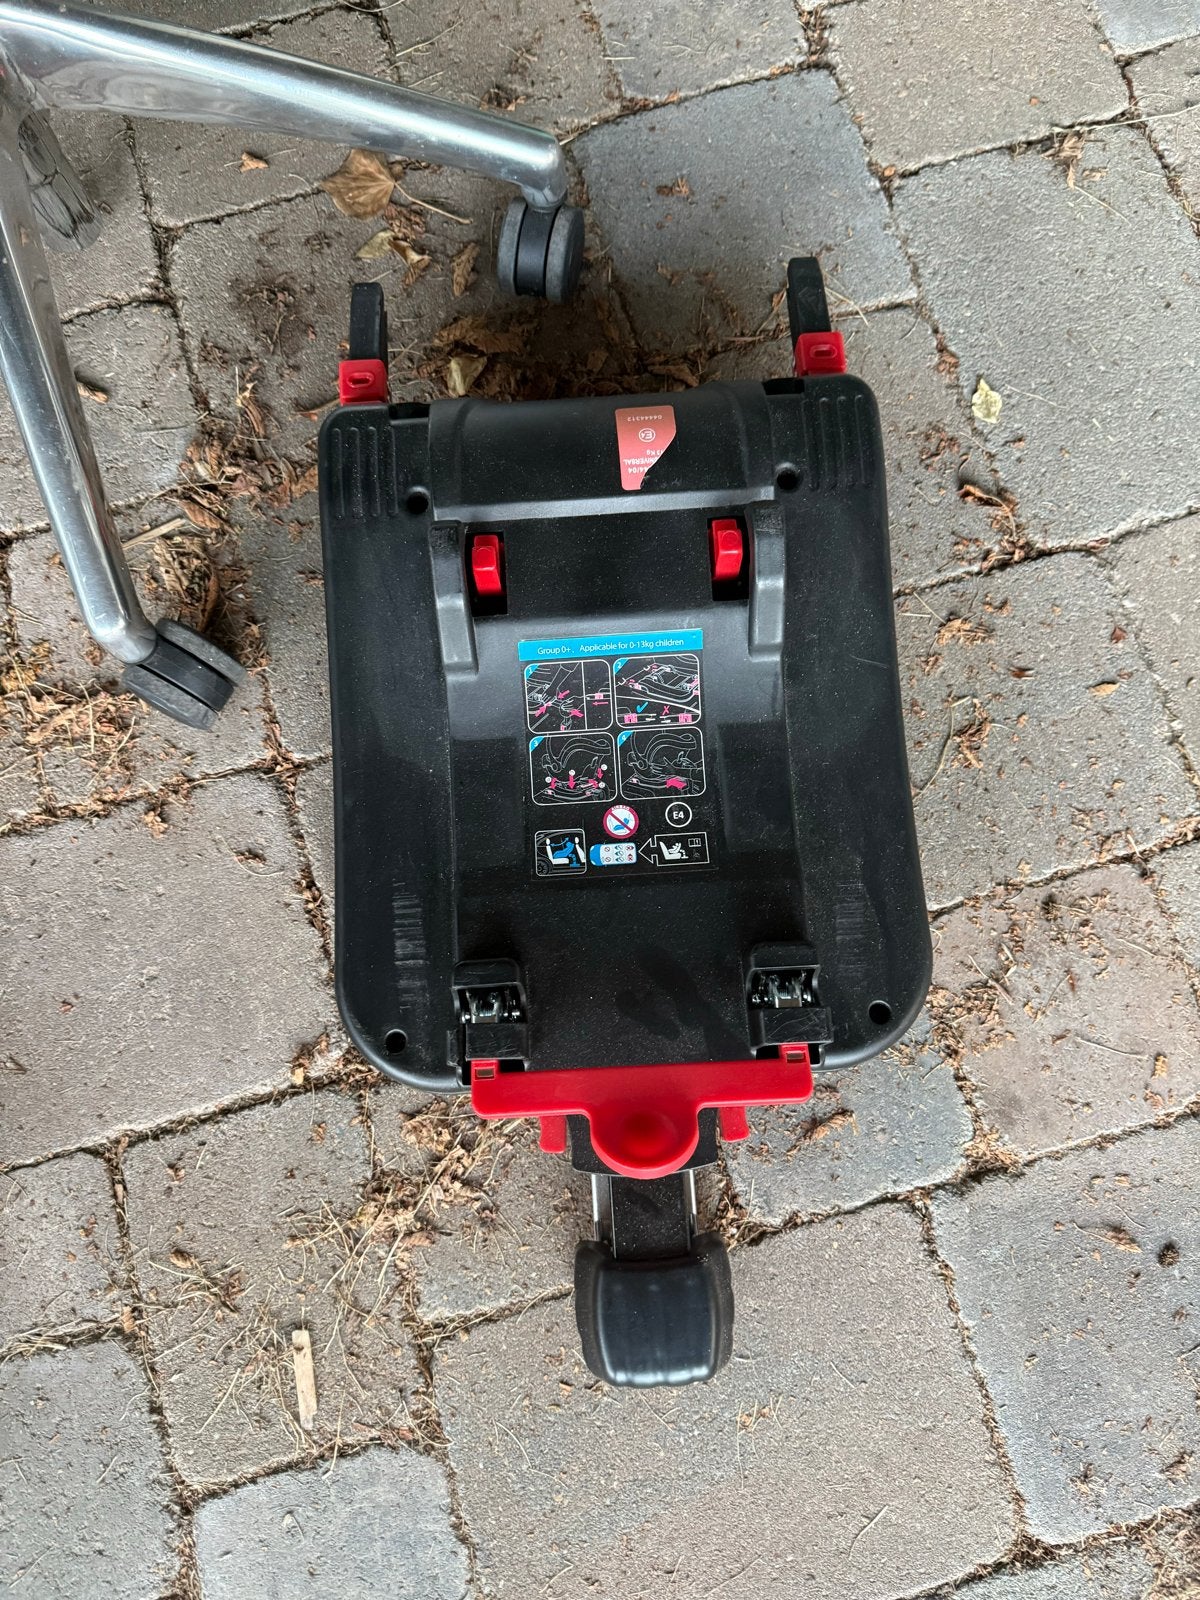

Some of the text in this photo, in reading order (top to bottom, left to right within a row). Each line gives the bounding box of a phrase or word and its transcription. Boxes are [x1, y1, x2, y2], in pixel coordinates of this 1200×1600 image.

[537, 646, 560, 655] Group
[580, 642, 618, 653] Applicable
[618, 641, 628, 649] for
[629, 640, 654, 649] 0-13kg
[655, 638, 685, 647] children
[673, 811, 684, 819] E4
